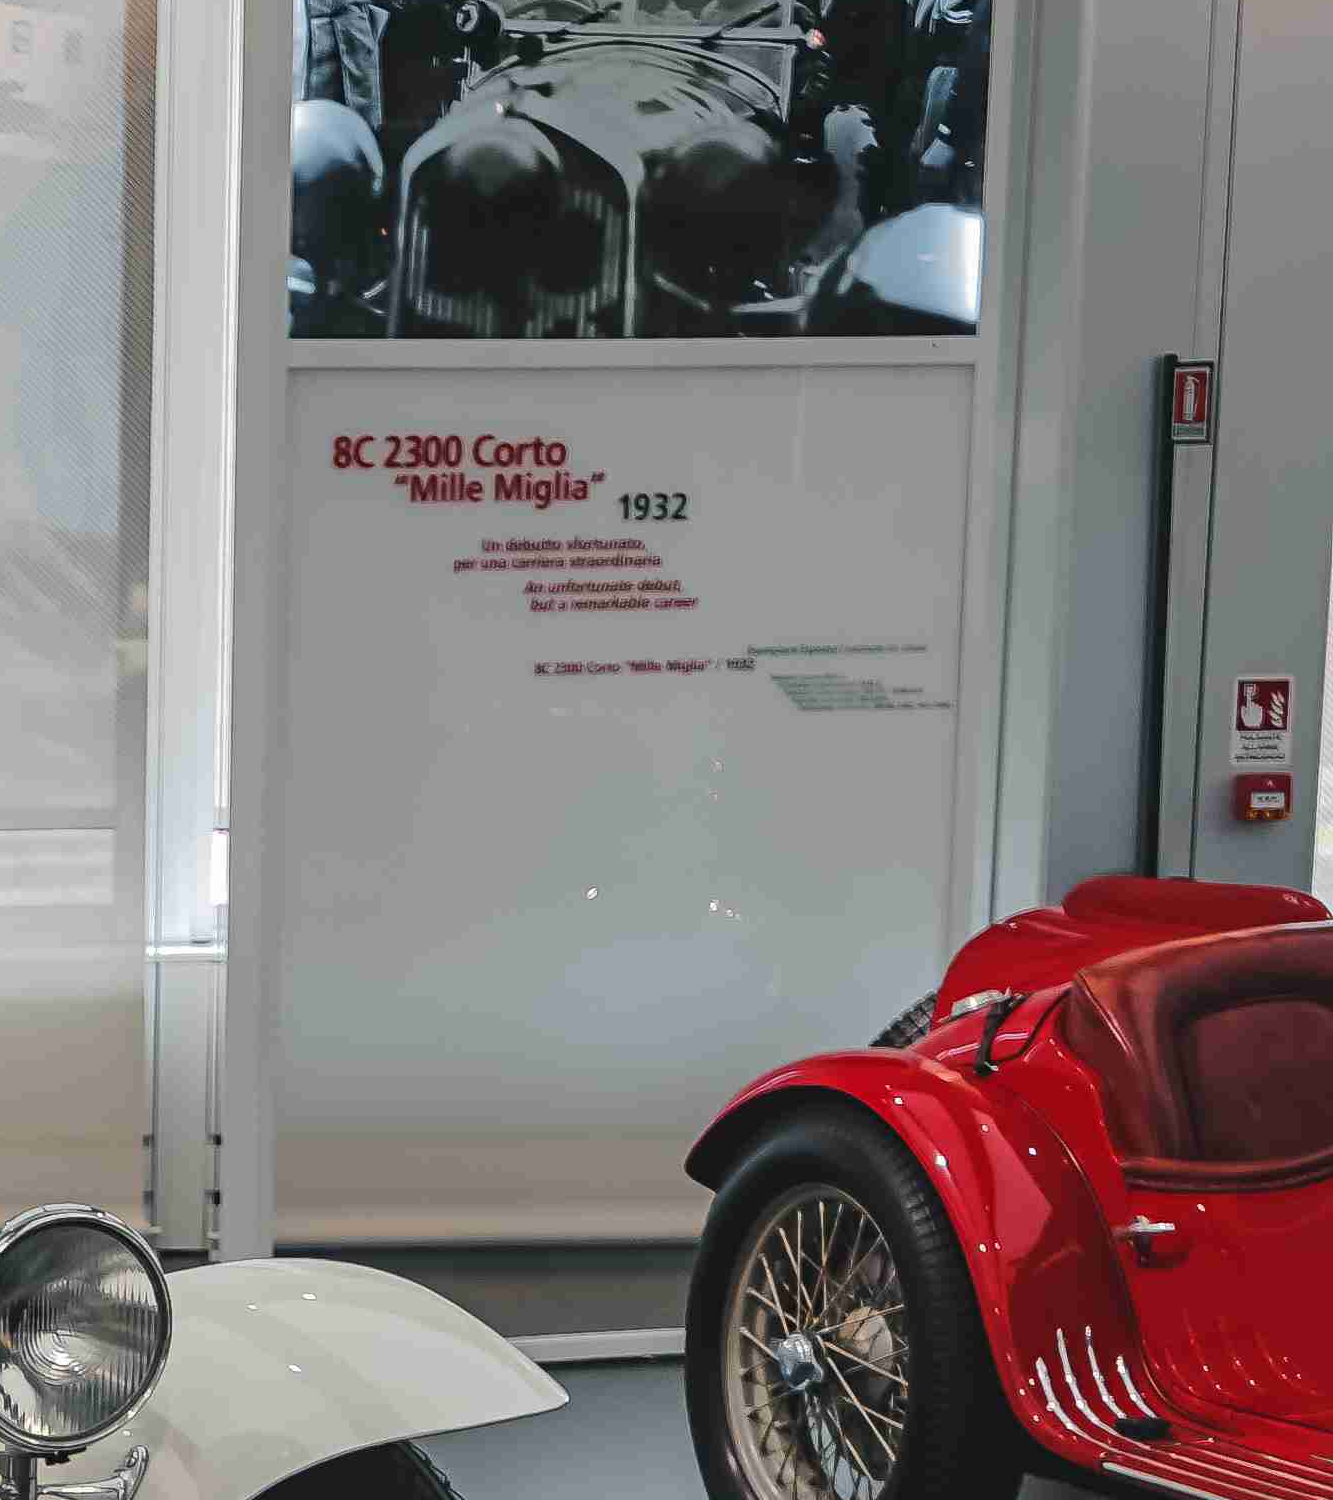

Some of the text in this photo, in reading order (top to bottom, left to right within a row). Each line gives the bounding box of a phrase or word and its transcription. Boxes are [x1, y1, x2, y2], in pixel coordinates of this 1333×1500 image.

[332, 433, 568, 469] 8C 2300 Corto
[619, 492, 689, 521] 1932
[453, 553, 662, 574] per una carriera straordinaria
[529, 598, 554, 613] but
